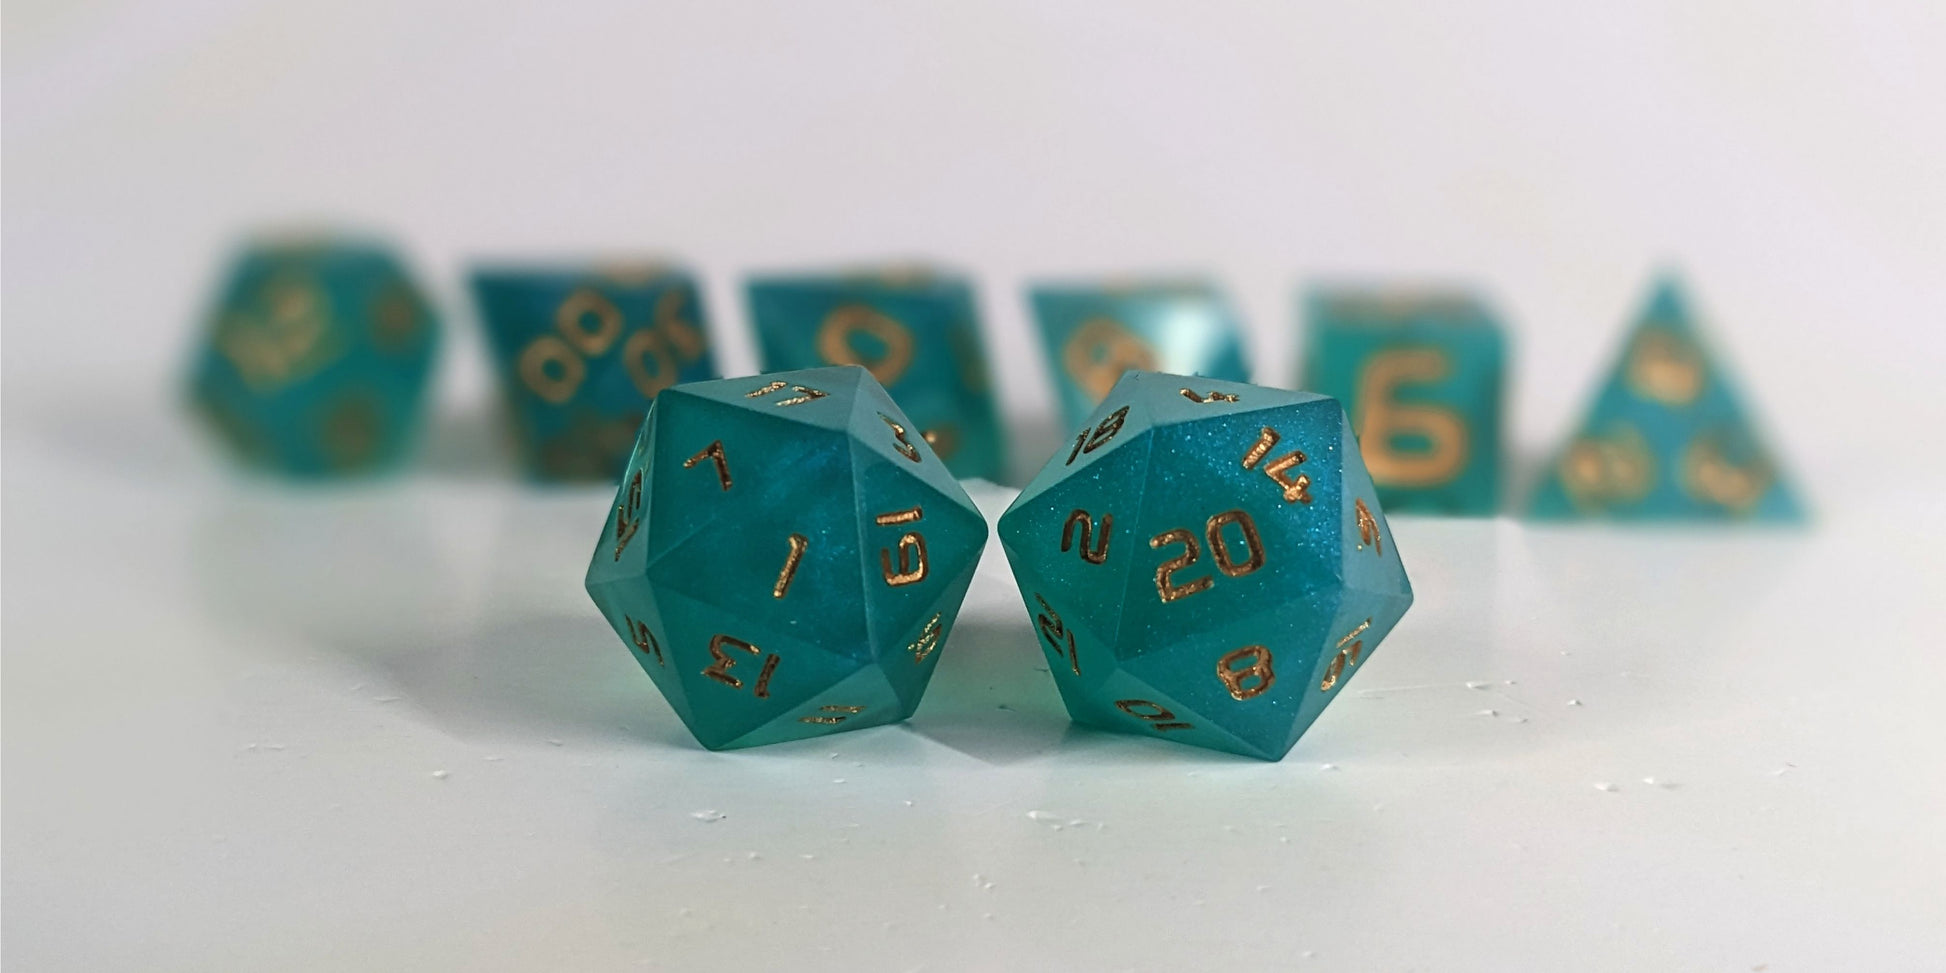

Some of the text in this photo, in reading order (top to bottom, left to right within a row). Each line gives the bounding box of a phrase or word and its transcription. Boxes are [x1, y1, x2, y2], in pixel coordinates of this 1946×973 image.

[518, 287, 622, 404] 00
[746, 381, 830, 406] 17
[1357, 345, 1470, 487] 6
[682, 439, 733, 491] 7
[877, 412, 922, 463] 3
[1065, 405, 1130, 466] 18
[1242, 426, 1312, 504] 14
[773, 533, 808, 599] 1
[875, 505, 929, 587] 19
[1060, 508, 1113, 565] 2
[1149, 509, 1266, 603] 20
[700, 633, 781, 698] 13
[1035, 593, 1081, 677] 12
[1216, 644, 1275, 702] 8
[798, 704, 866, 724] 11
[1114, 699, 1195, 732] 10
